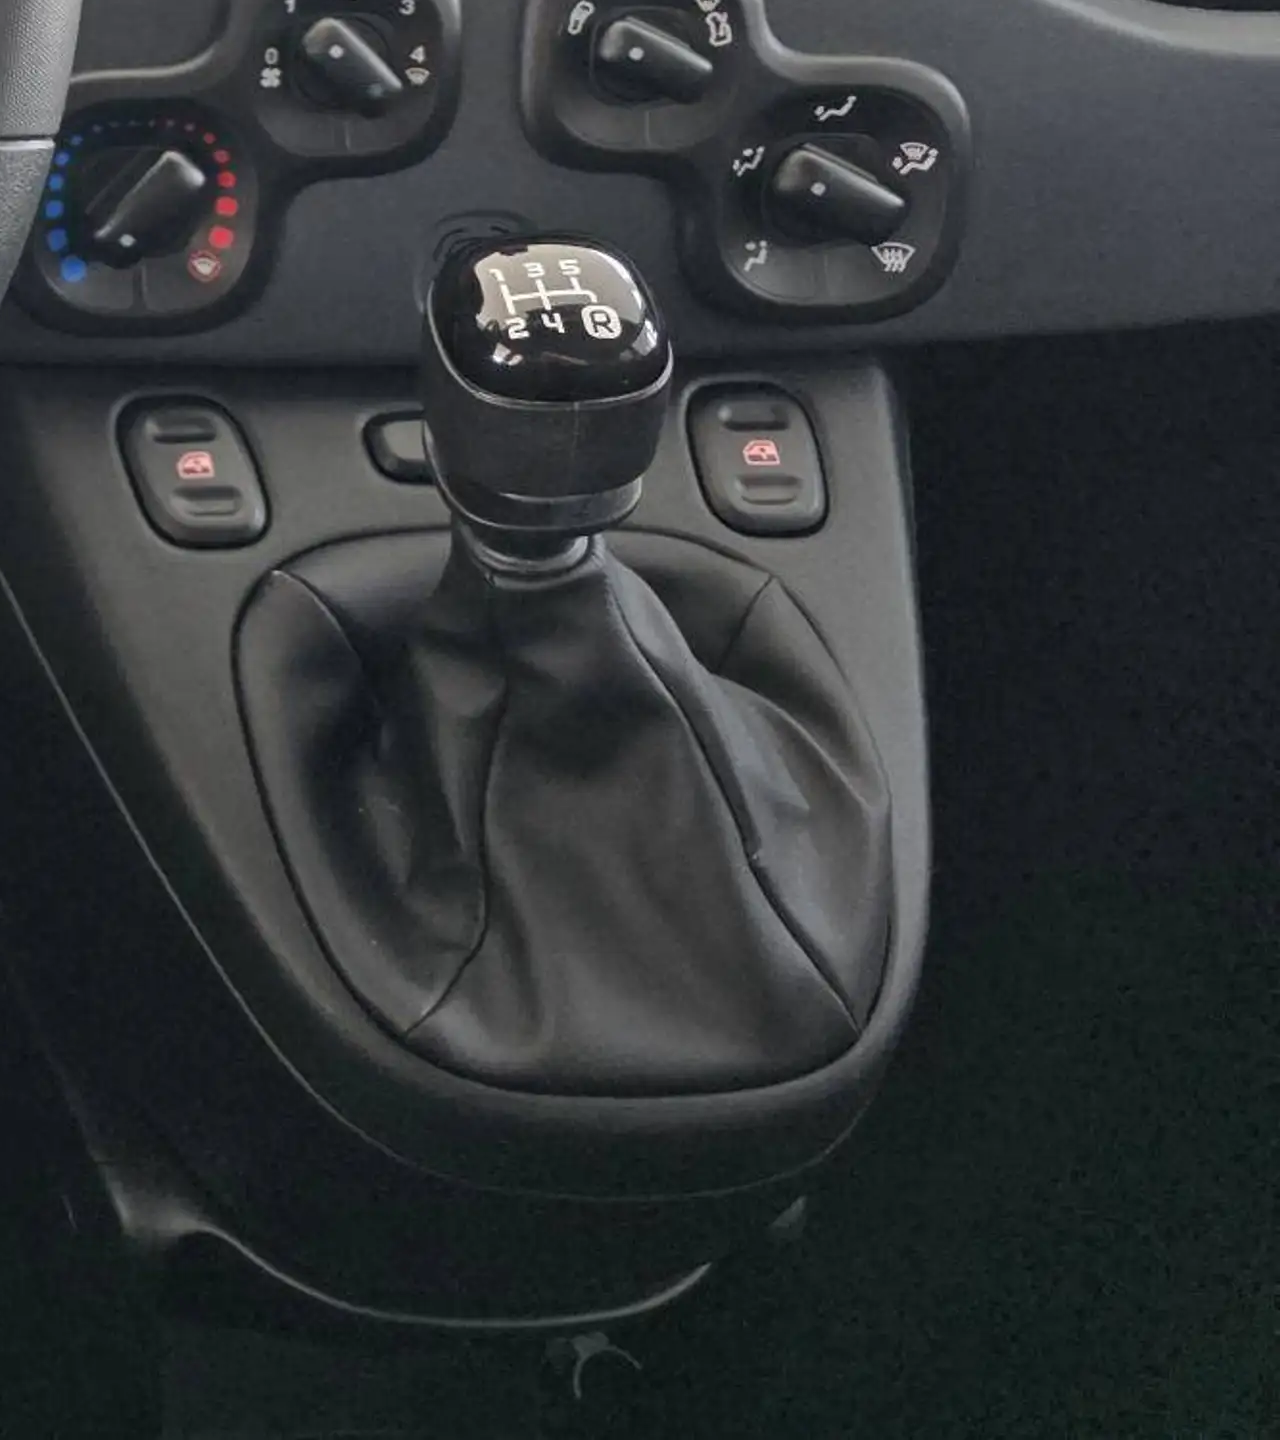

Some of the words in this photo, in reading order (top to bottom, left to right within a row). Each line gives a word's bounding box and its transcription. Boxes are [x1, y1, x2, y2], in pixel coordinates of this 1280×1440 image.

[409, 45, 426, 63] 4
[524, 262, 546, 278] 3
[558, 260, 581, 275] 5
[504, 318, 530, 340] 2
[541, 312, 565, 333] 4
